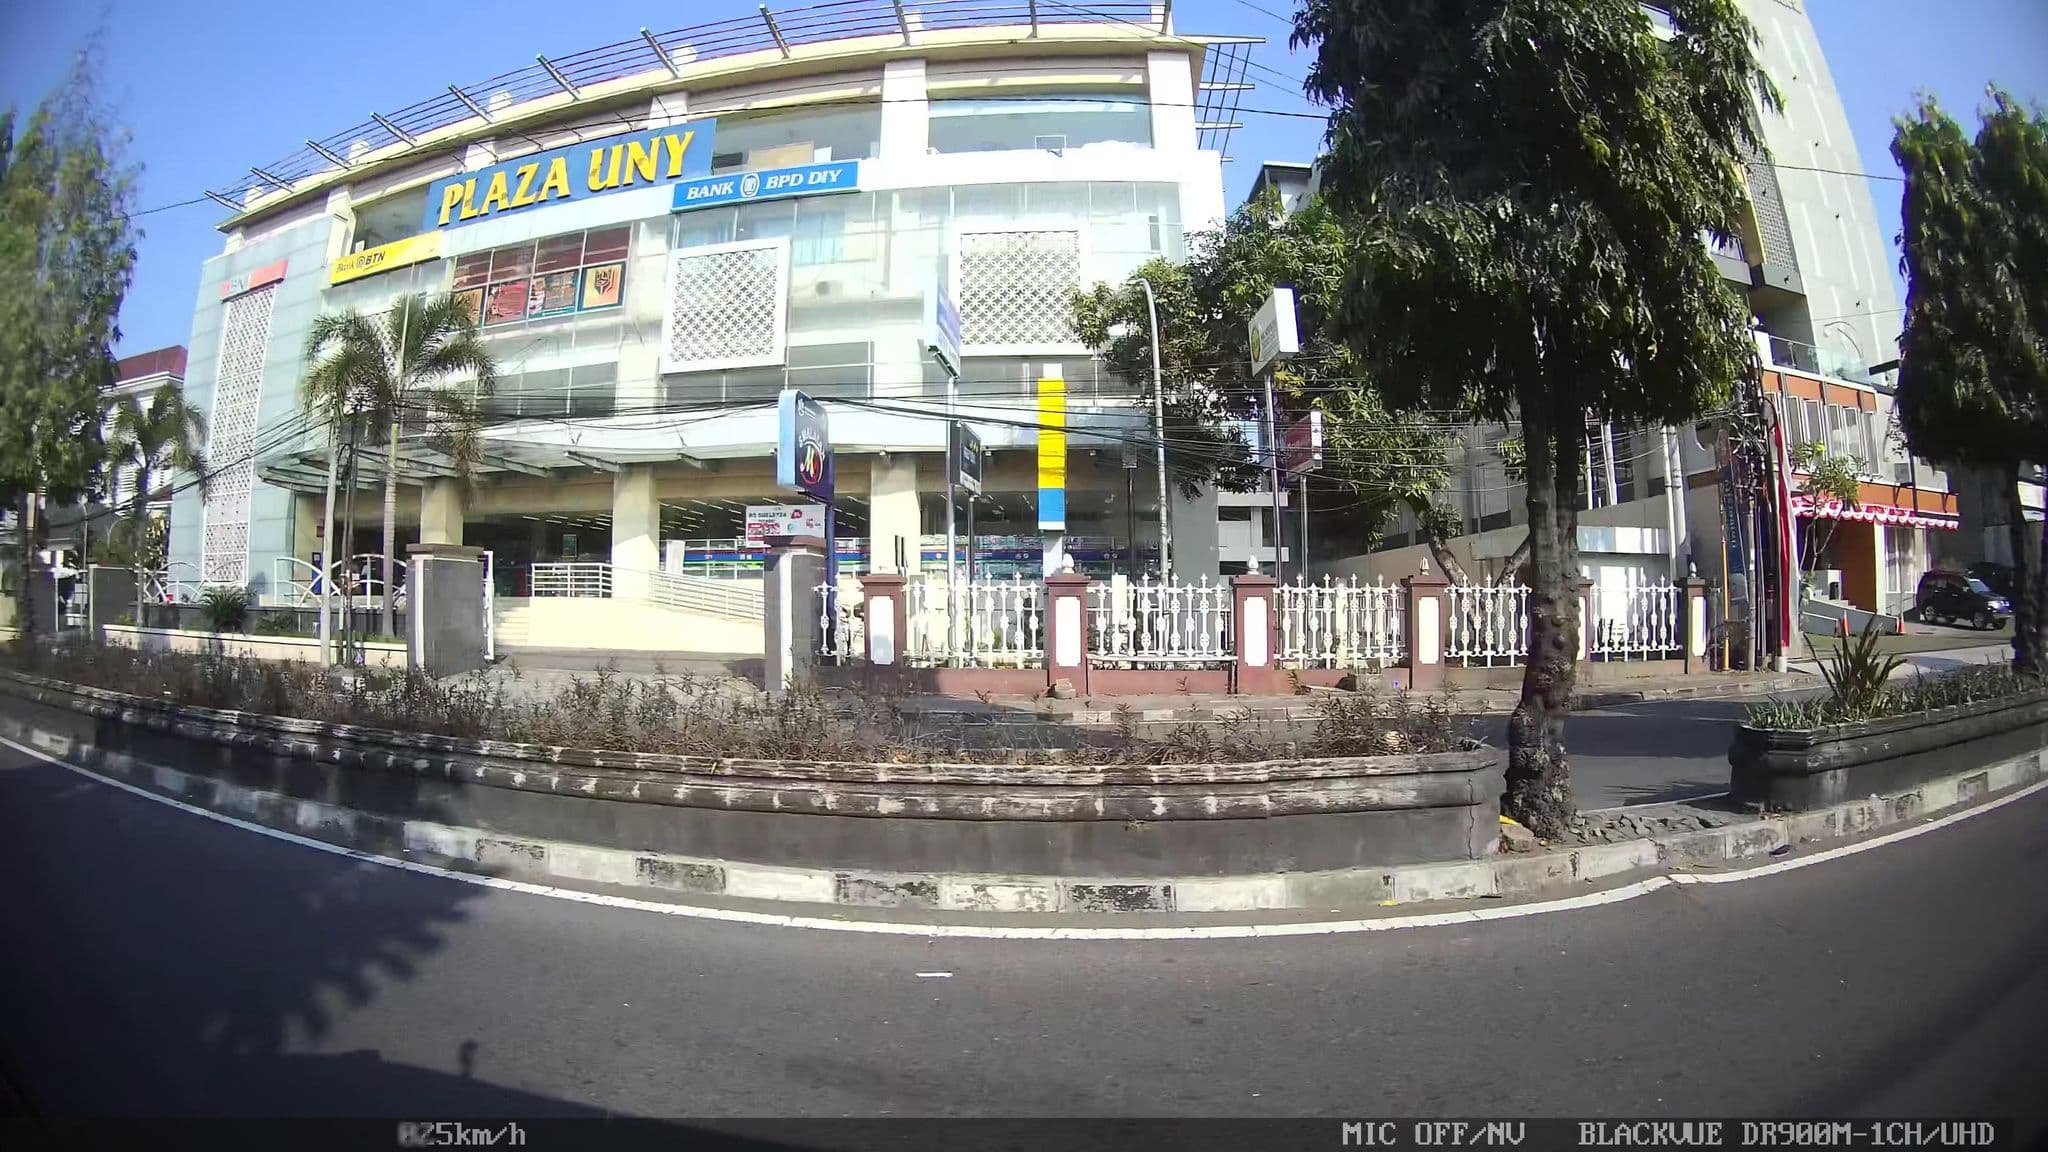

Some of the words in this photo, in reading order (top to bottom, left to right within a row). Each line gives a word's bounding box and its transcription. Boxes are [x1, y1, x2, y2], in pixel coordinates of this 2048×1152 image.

[438, 157, 570, 226] PLAZA
[587, 131, 694, 192] UNY
[686, 181, 734, 200] BANK
[765, 173, 804, 190] BPD
[808, 169, 842, 185] DIY
[365, 251, 386, 265] BTN
